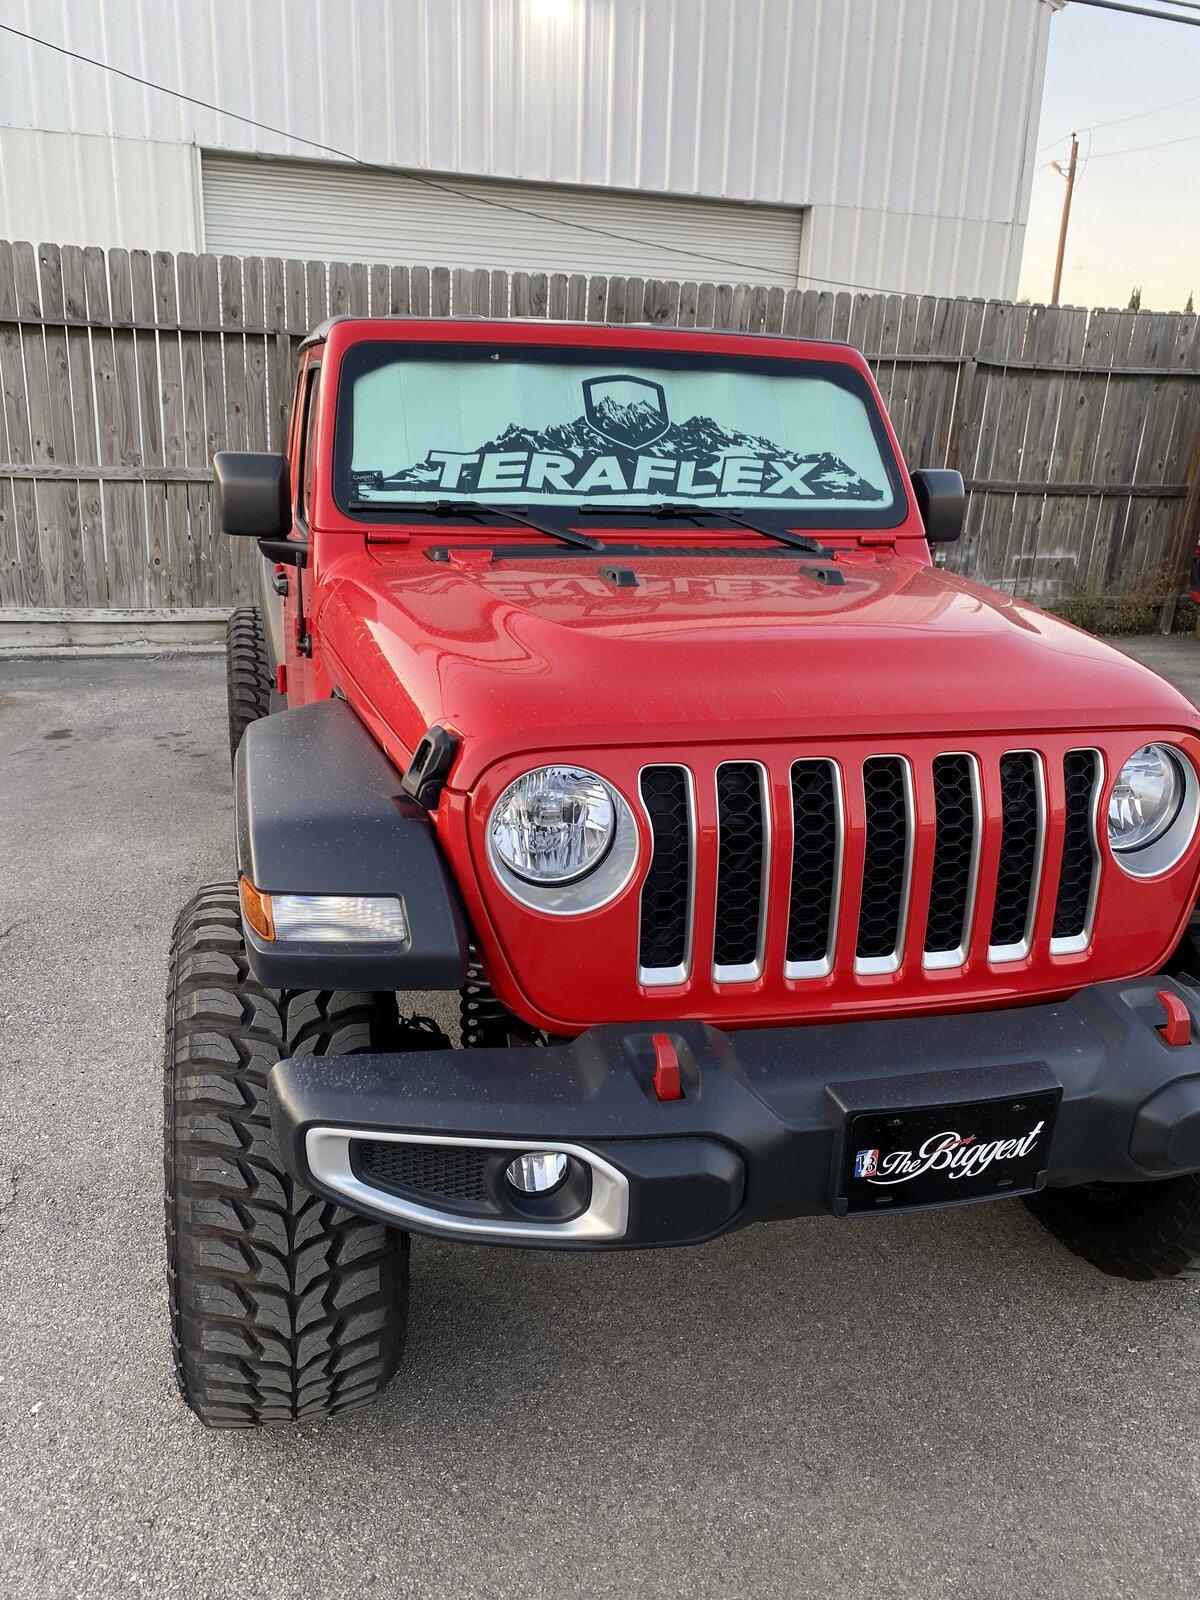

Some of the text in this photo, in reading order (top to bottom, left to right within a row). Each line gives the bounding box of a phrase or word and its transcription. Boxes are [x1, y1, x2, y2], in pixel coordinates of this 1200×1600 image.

[429, 451, 820, 496] TERAFLEX
[876, 1121, 1045, 1179] The Biggest
